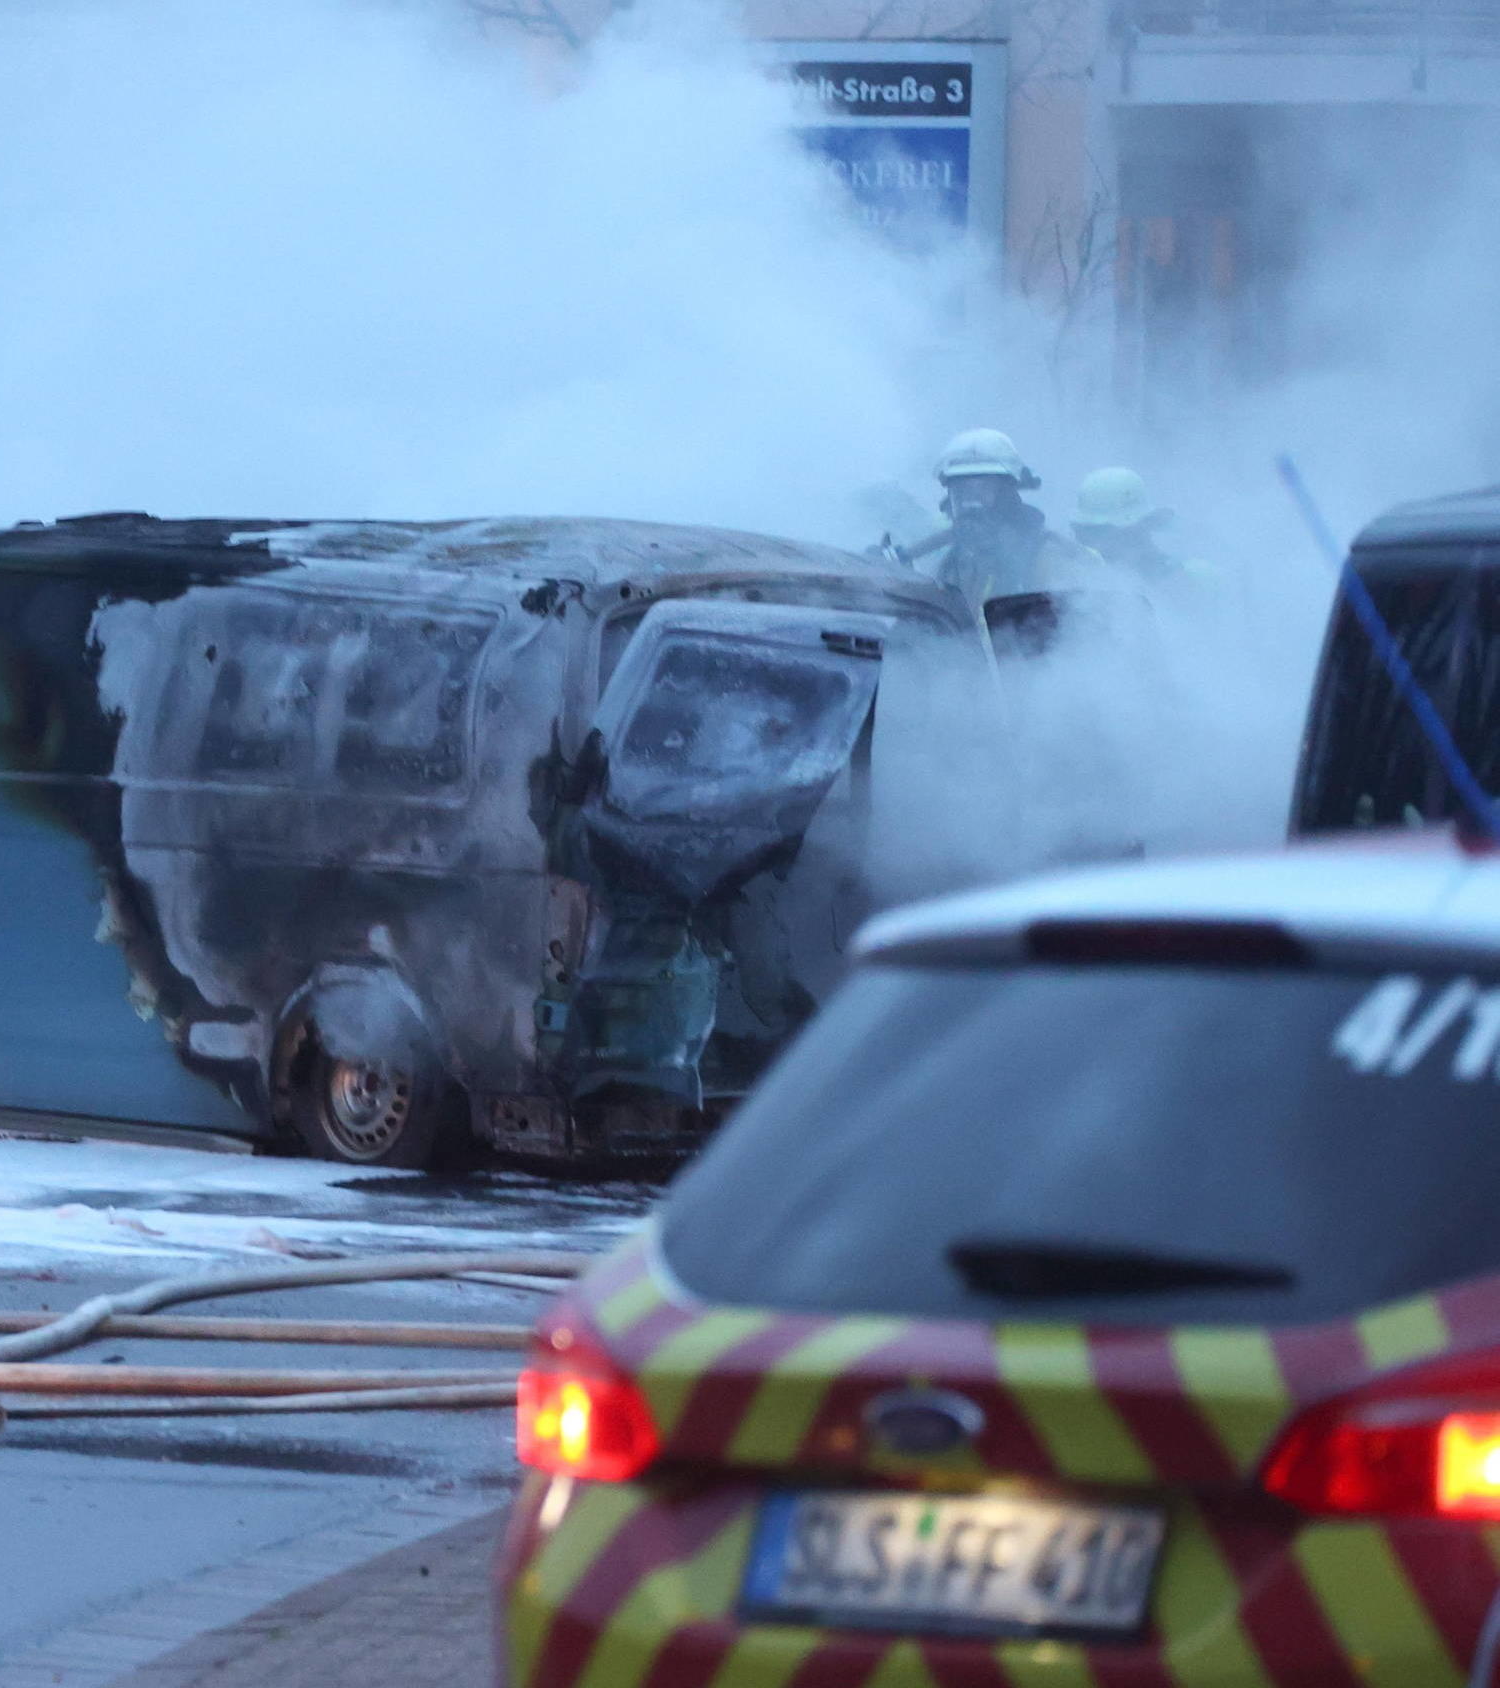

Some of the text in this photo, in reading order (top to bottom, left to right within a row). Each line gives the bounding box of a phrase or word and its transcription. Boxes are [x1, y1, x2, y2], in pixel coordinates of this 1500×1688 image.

[947, 79, 964, 103] 3
[1329, 972, 1500, 1083] 4/1
[935, 1517, 1023, 1600] FF
